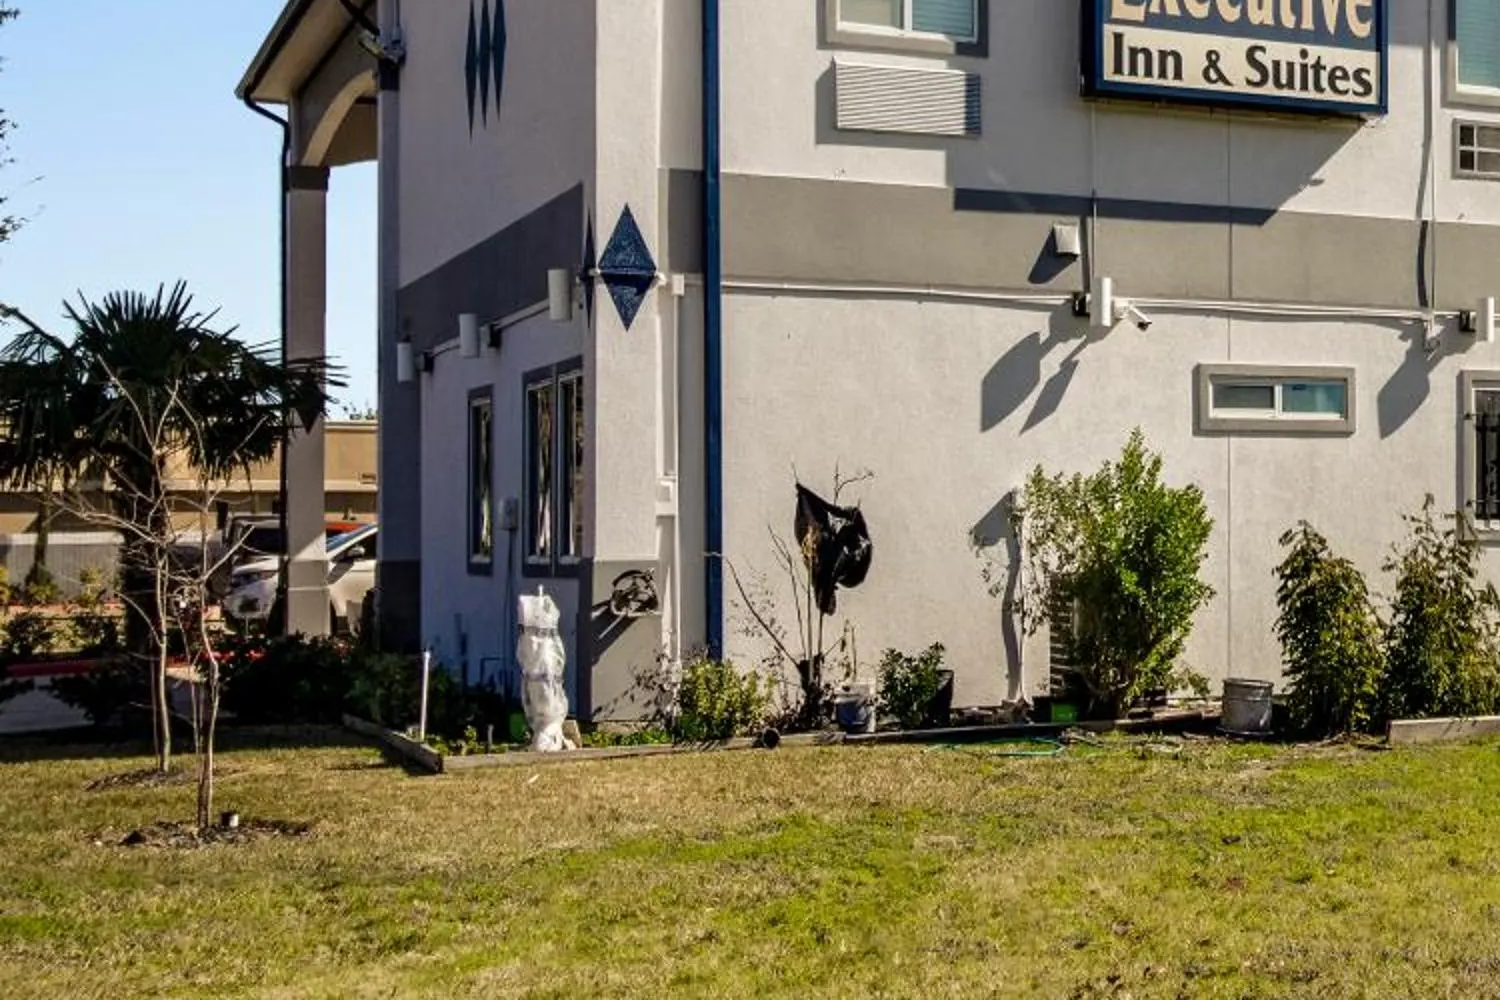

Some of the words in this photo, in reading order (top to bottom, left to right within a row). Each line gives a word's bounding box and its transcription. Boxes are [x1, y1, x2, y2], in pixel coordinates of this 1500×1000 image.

[1111, 31, 1184, 81] Inn
[1201, 49, 1234, 87] &
[1245, 44, 1373, 98] Suites
